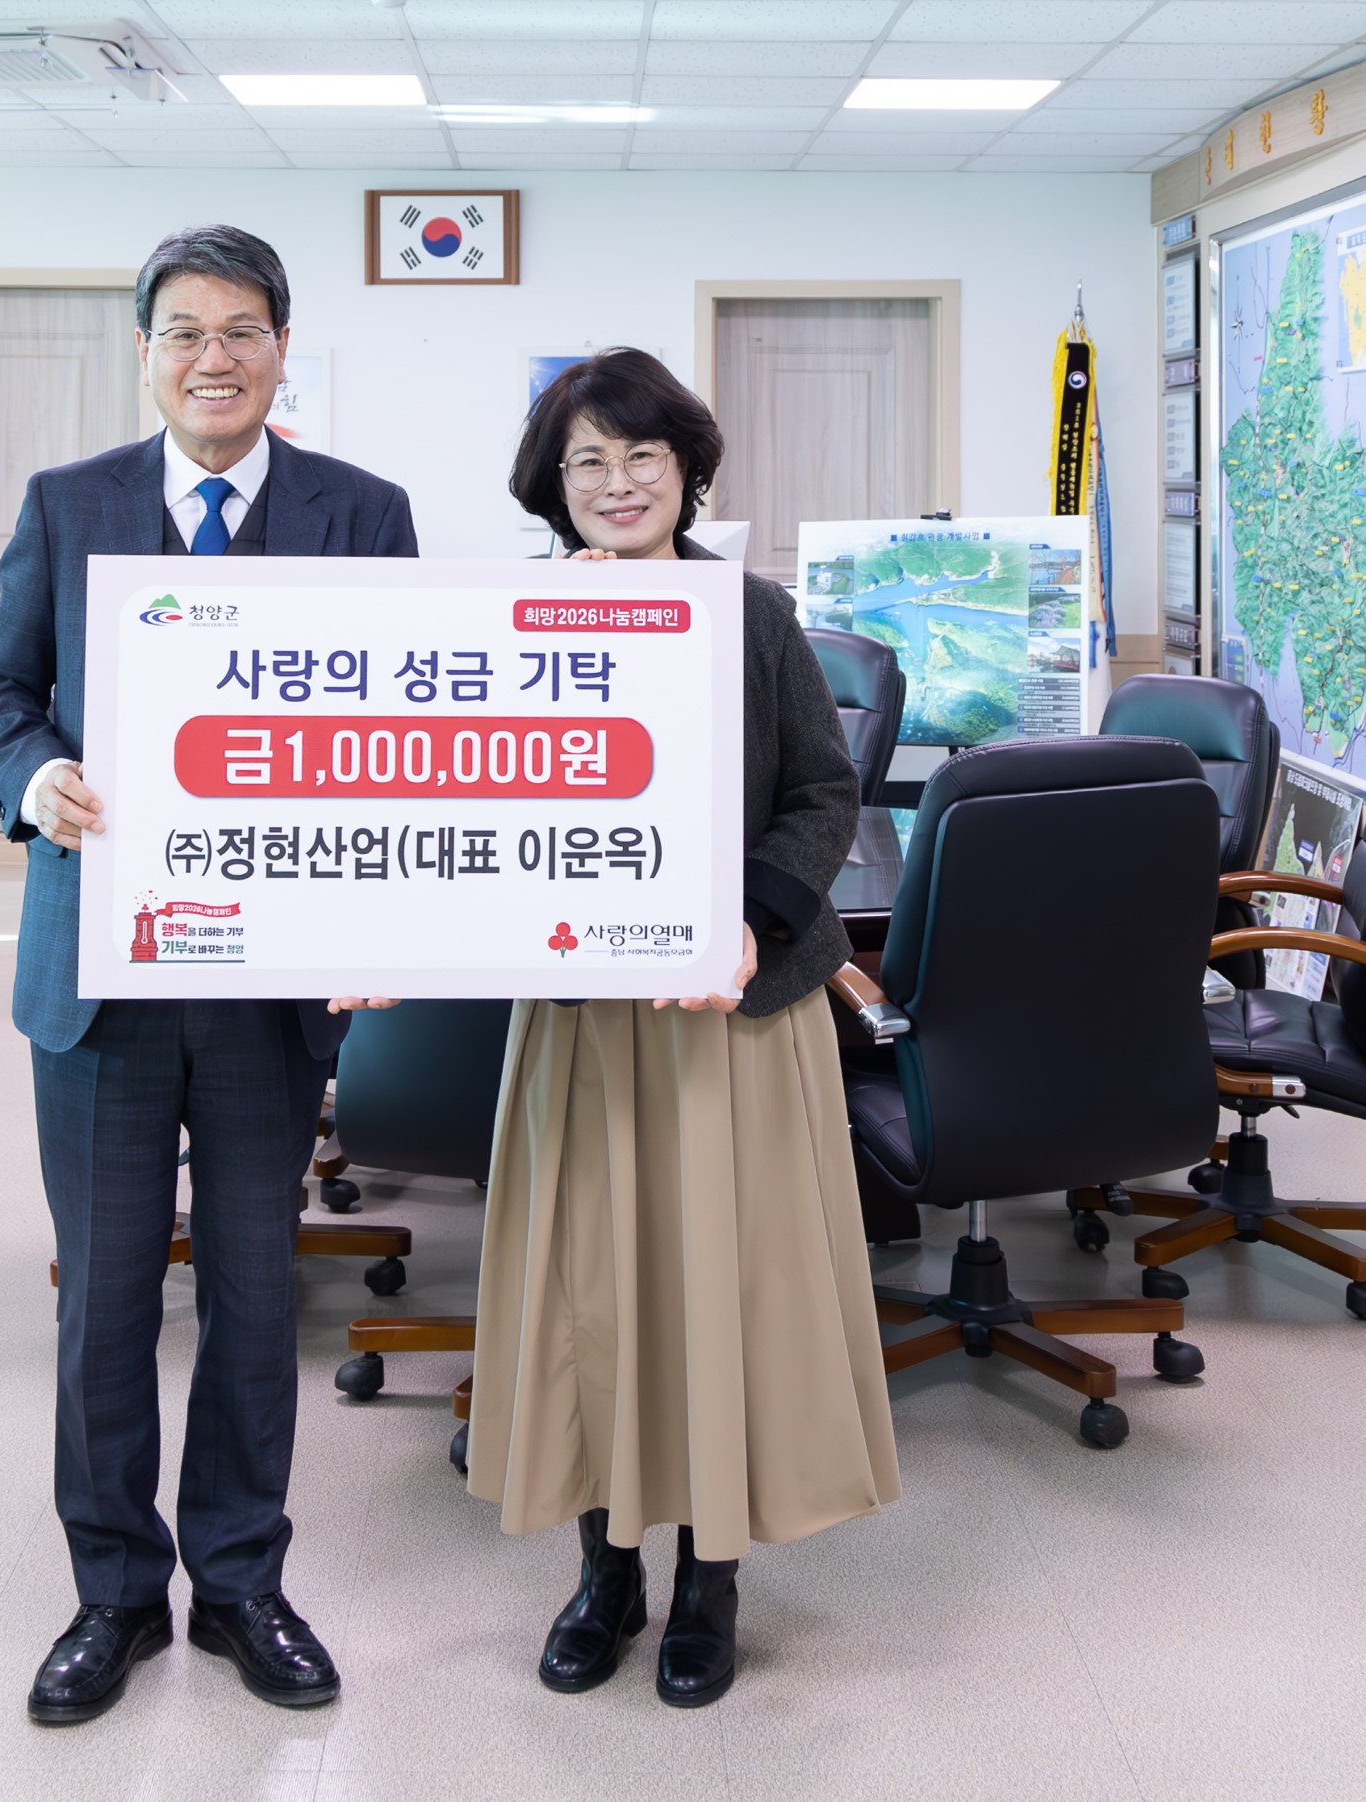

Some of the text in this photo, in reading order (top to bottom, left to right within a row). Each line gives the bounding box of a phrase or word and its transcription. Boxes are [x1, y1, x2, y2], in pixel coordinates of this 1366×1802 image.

[947, 531, 980, 542] 개발사업
[189, 605, 240, 621] 청양군
[523, 606, 678, 627] 희망2026나눔캠페인
[216, 648, 617, 704] 사랑의 성금 기탁
[224, 729, 608, 787] 금1,000,000원
[519, 823, 664, 881] 이운옥)
[161, 922, 244, 938] 행복을 더하는 기부
[584, 924, 693, 947] 사랑의열매
[161, 940, 244, 955] 기부로 바꾸는 청양
